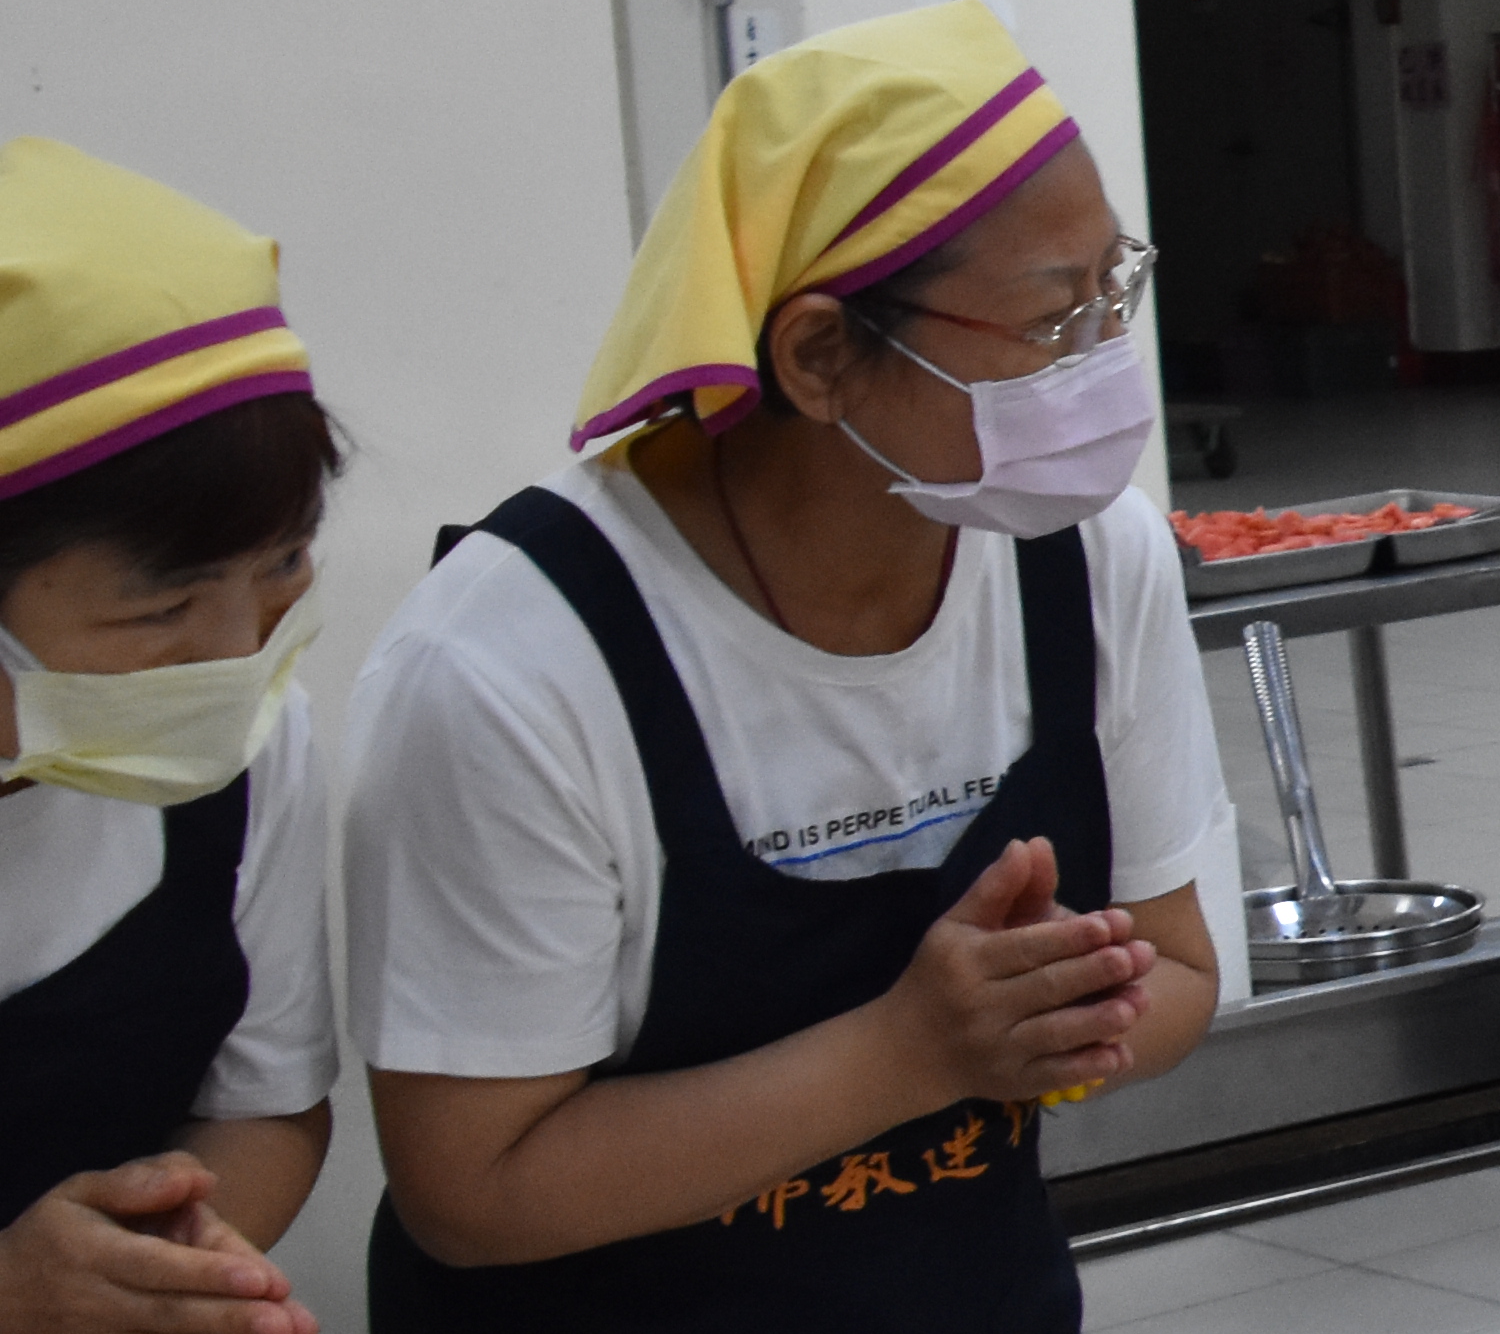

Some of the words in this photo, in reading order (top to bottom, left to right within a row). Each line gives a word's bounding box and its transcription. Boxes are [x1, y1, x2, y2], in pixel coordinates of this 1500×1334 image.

[798, 824, 820, 848] IS
[825, 786, 957, 841] PERPETUAL
[964, 773, 1008, 800] FE
